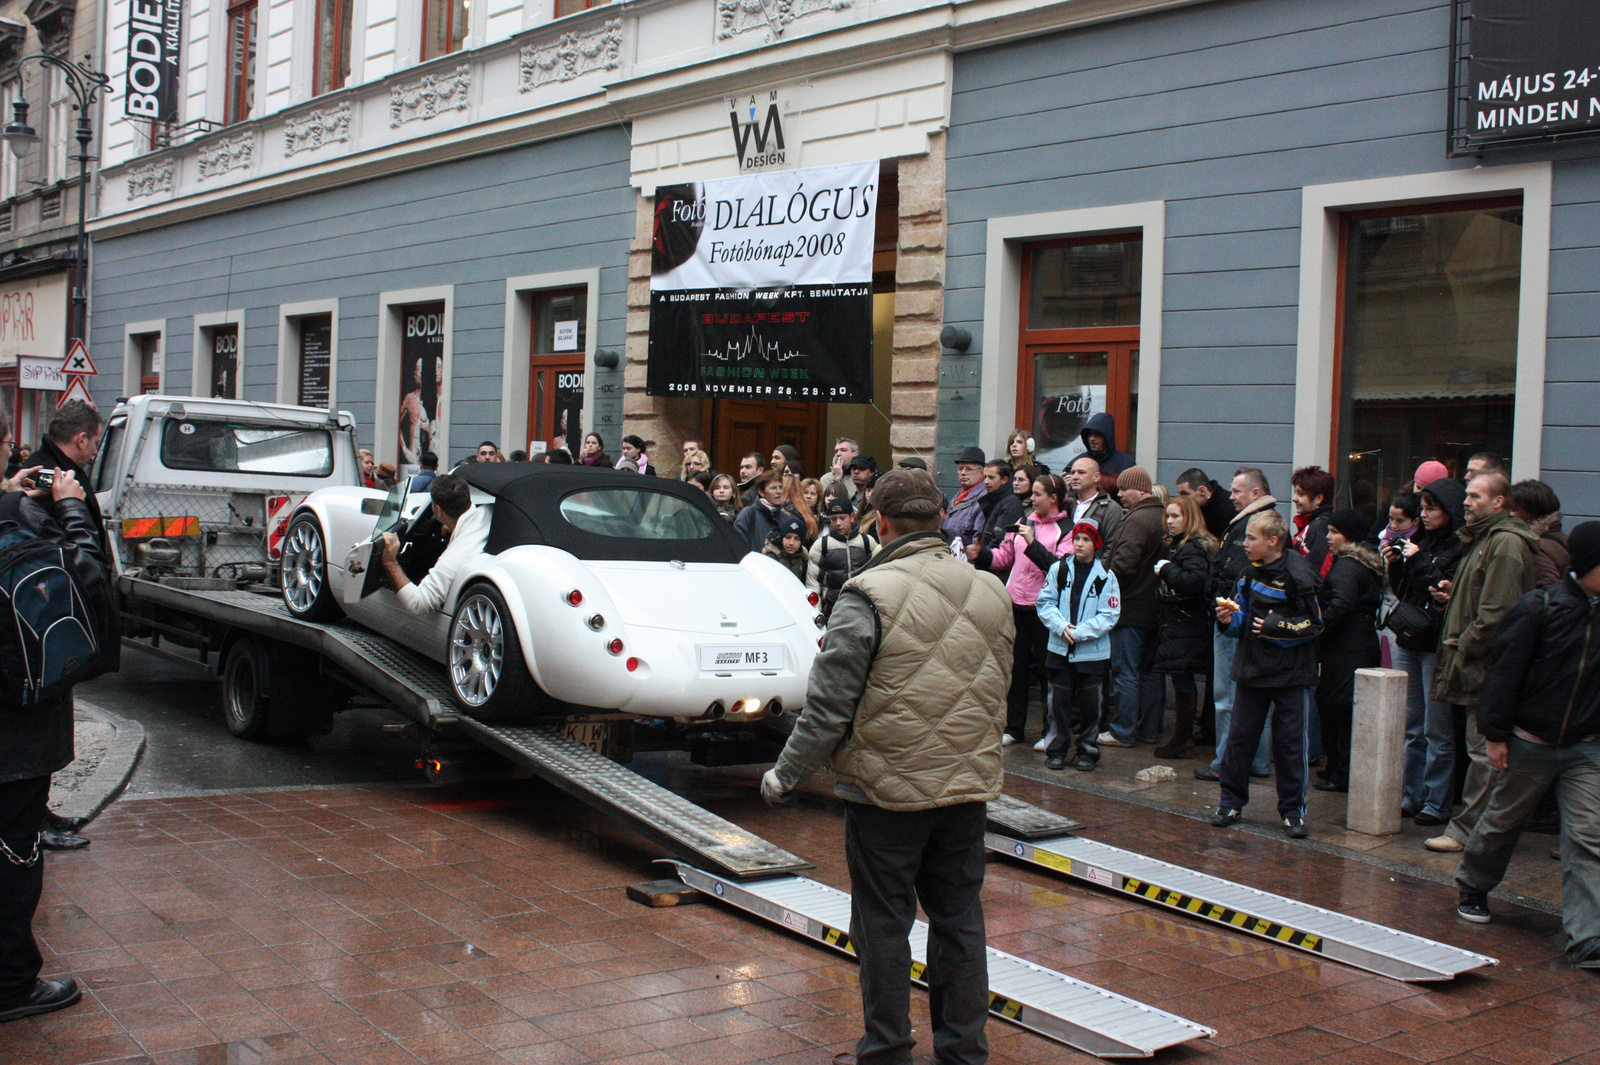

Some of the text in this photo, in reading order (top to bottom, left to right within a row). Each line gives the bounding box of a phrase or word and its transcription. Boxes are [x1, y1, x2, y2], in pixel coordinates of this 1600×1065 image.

[164, 0, 181, 66] A KIÁLLÍT
[128, 0, 164, 118] BODIE
[1478, 66, 1600, 102] MÁJUS 24-
[1477, 99, 1579, 130] MINDEN
[746, 151, 785, 169] DESIGN
[671, 196, 706, 223] Fotó
[713, 183, 874, 231] DIALÓGUS
[670, 293, 711, 302] BUDAPEST
[714, 292, 750, 300] FASHION
[755, 291, 780, 300] WEEK
[784, 290, 805, 299] KFT.
[809, 288, 869, 298] BEMUTATJA
[701, 312, 811, 324] BUDAPEST
[700, 366, 810, 379] FASHION WEEK
[668, 383, 697, 391] 2008
[705, 384, 772, 394] NOVEMBER
[1055, 395, 1092, 413] Fotó
